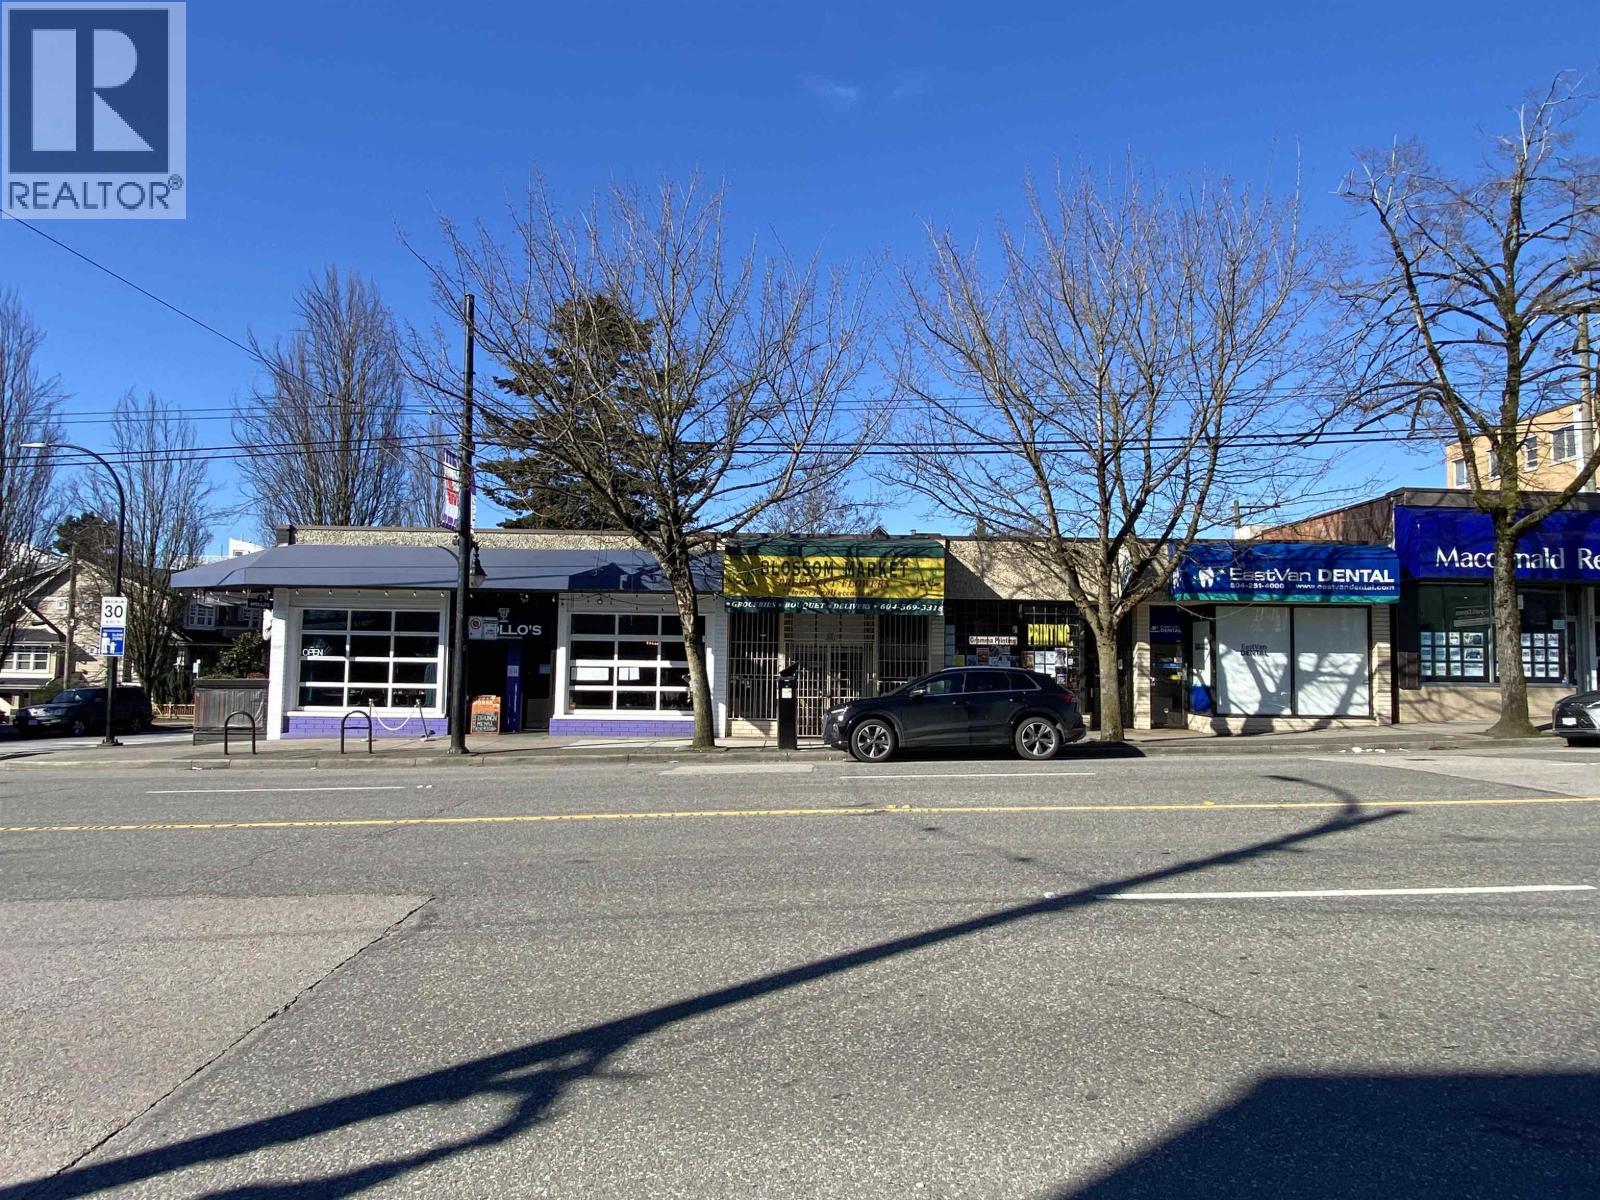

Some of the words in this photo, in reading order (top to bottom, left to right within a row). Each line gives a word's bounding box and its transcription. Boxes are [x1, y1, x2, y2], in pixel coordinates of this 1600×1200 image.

[1435, 545, 1566, 570] Macnald
[760, 560, 834, 578] BLOSSOM
[844, 560, 909, 579] MARKET
[1229, 567, 1312, 582] EastVan
[1317, 568, 1395, 583] DENTAL
[104, 604, 124, 618] 30
[731, 601, 776, 609] GROCERIES
[784, 602, 825, 610] BOUQUET
[496, 624, 542, 636] LLO'S
[1027, 623, 1072, 647] PRINTING
[302, 648, 324, 657] OPEN
